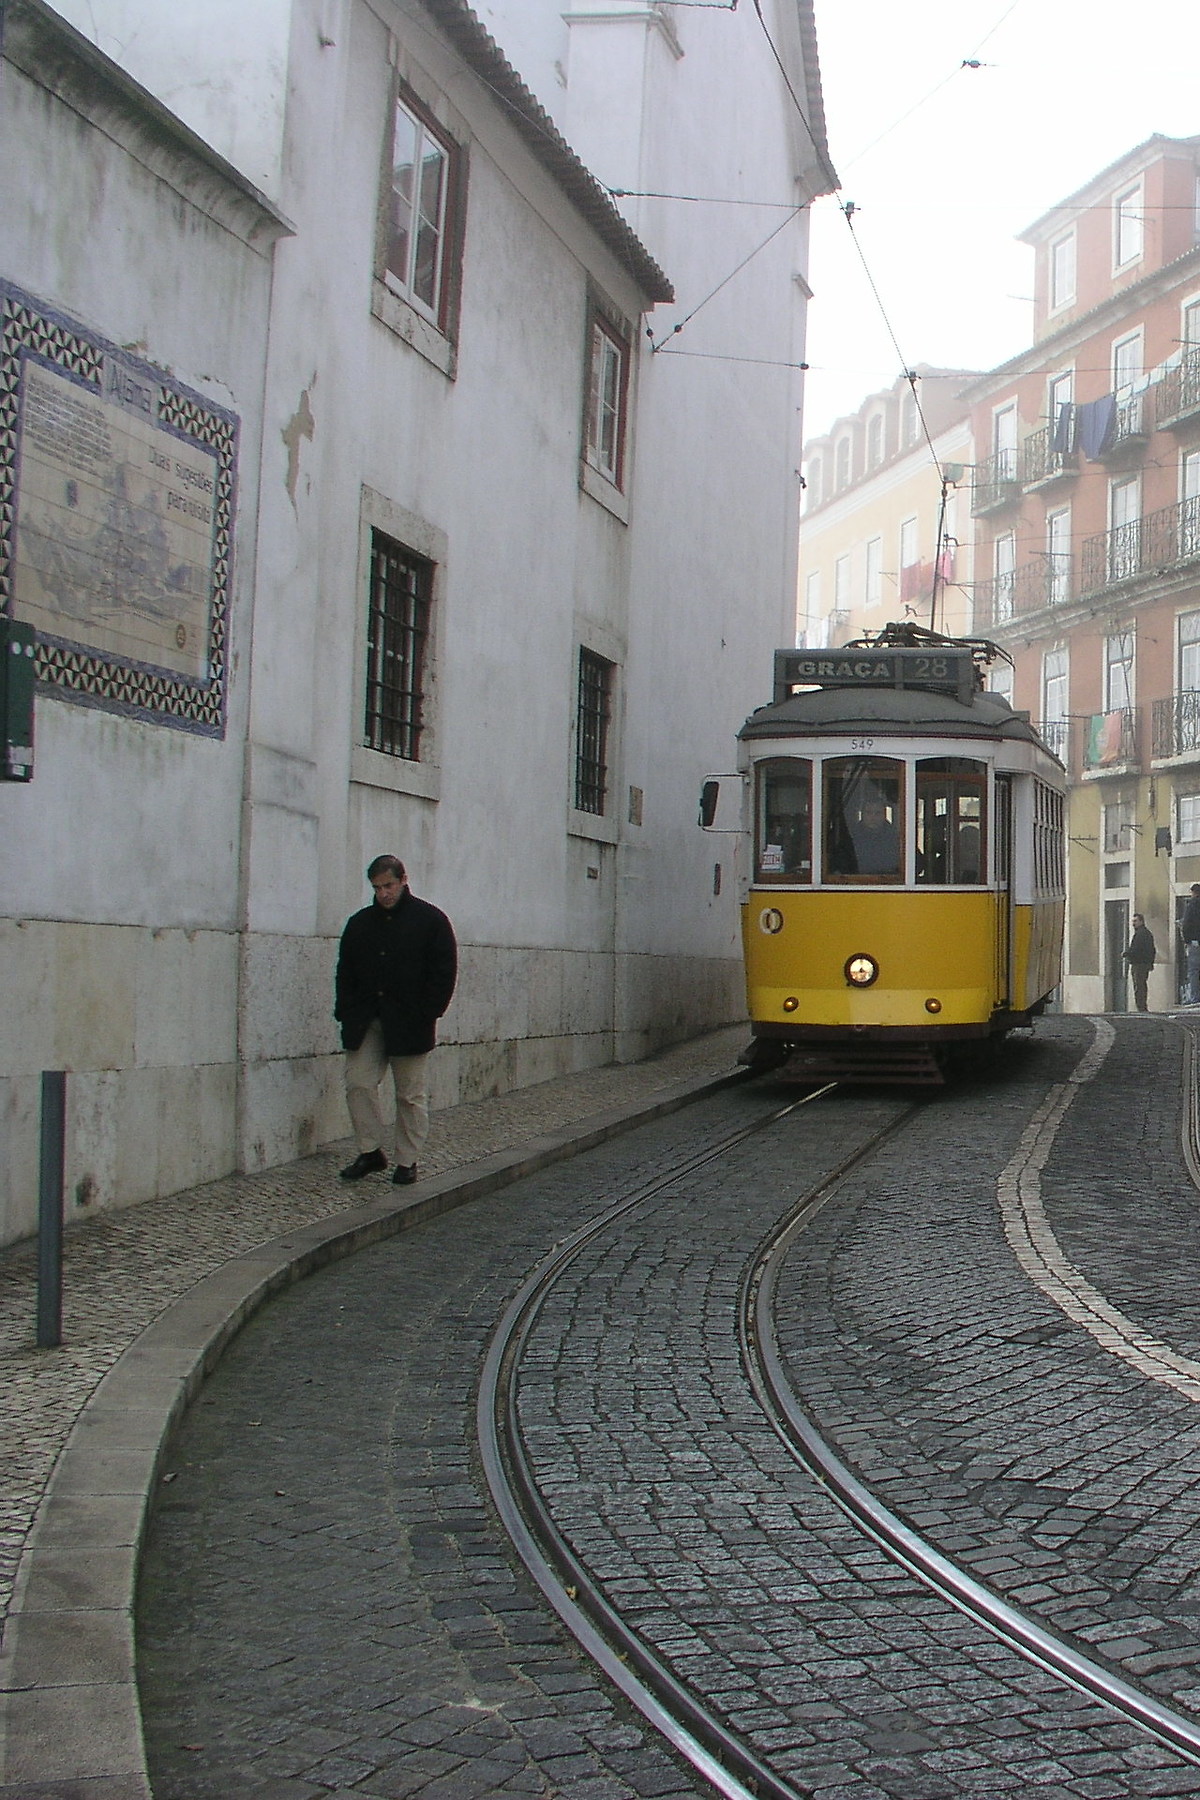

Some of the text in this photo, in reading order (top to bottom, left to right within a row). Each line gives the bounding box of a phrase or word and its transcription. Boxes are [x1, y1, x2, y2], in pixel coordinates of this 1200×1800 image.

[176, 462, 213, 495] sugestões
[798, 658, 948, 679] GRAÇA 28
[852, 738, 874, 750] 549
